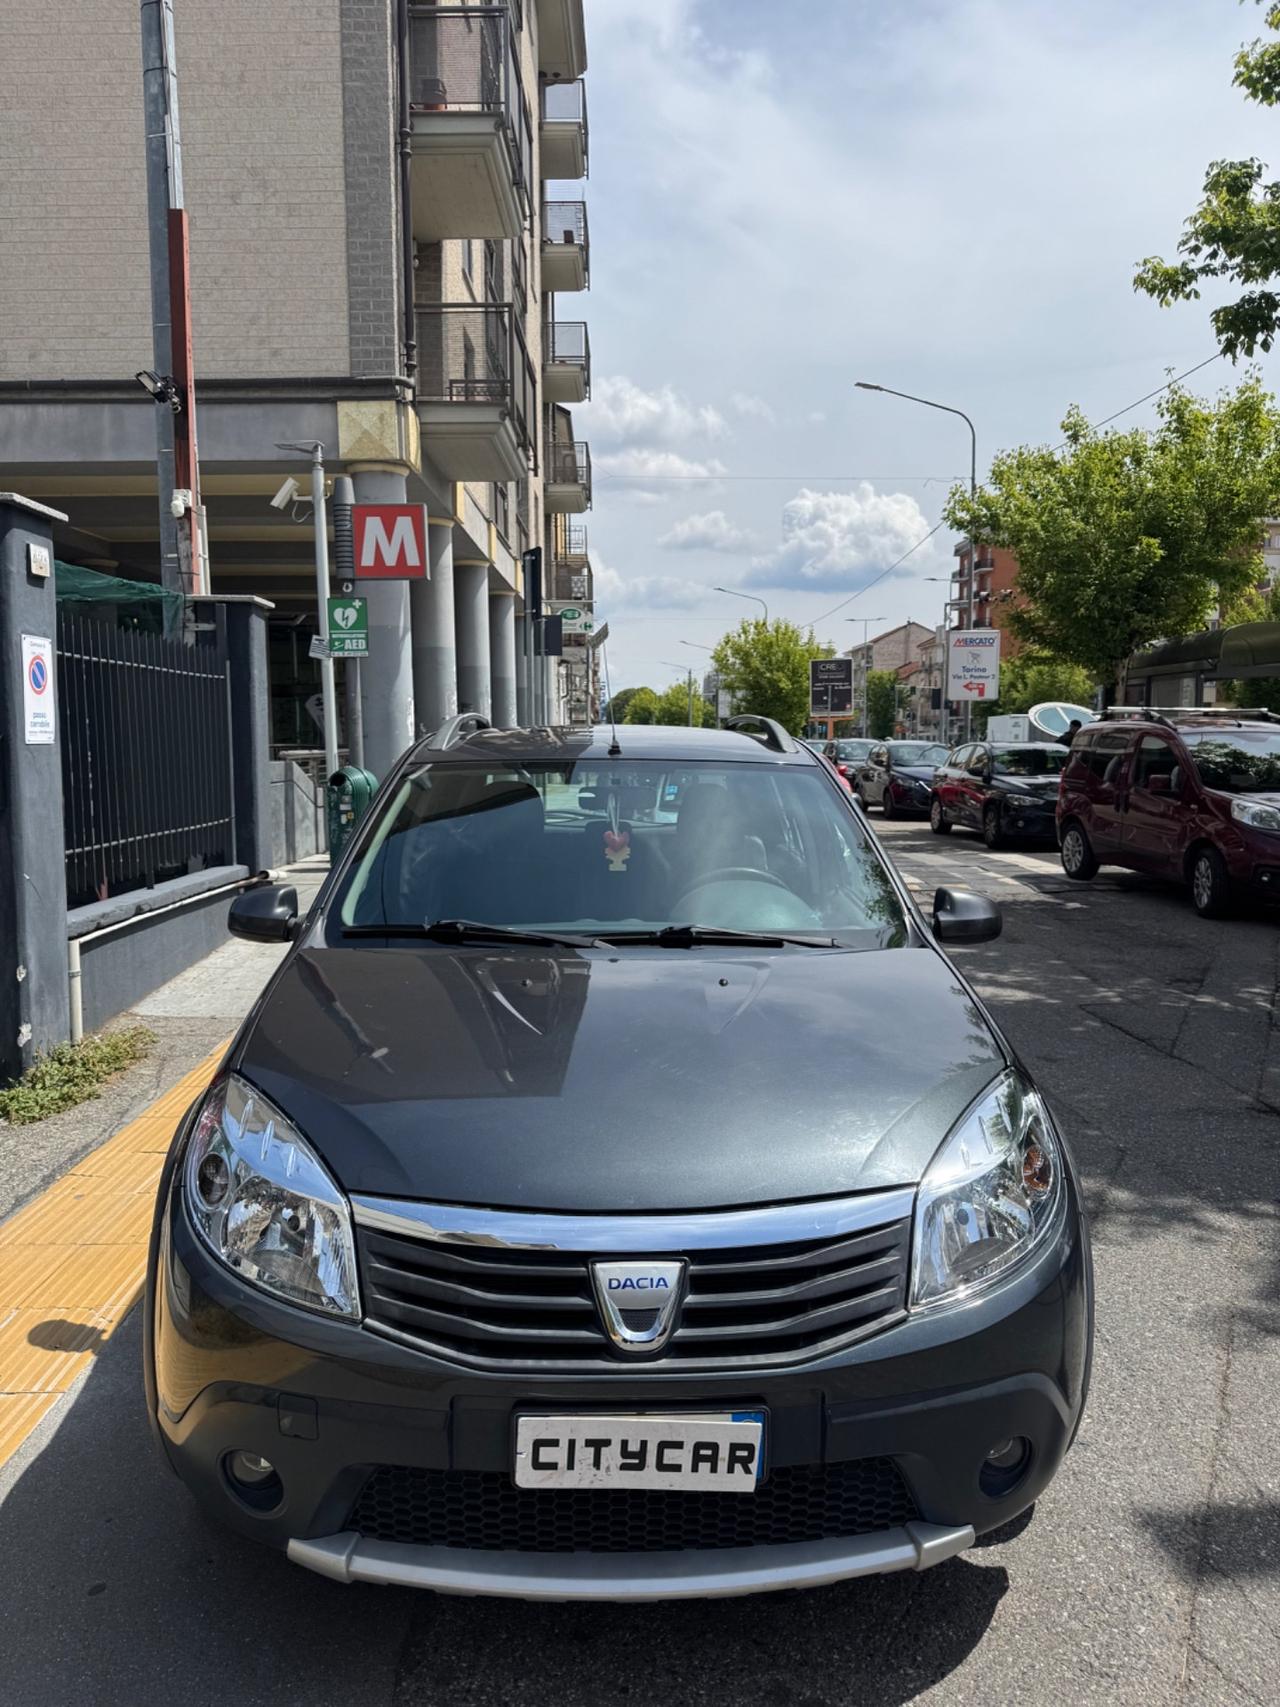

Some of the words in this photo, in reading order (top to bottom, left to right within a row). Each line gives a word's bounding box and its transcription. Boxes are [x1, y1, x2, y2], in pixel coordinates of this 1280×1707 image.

[361, 516, 421, 567] M
[344, 639, 367, 650] AED
[961, 665, 987, 673] Torino
[608, 1277, 669, 1290] DACIA
[531, 1438, 756, 1475] CITYCAR
